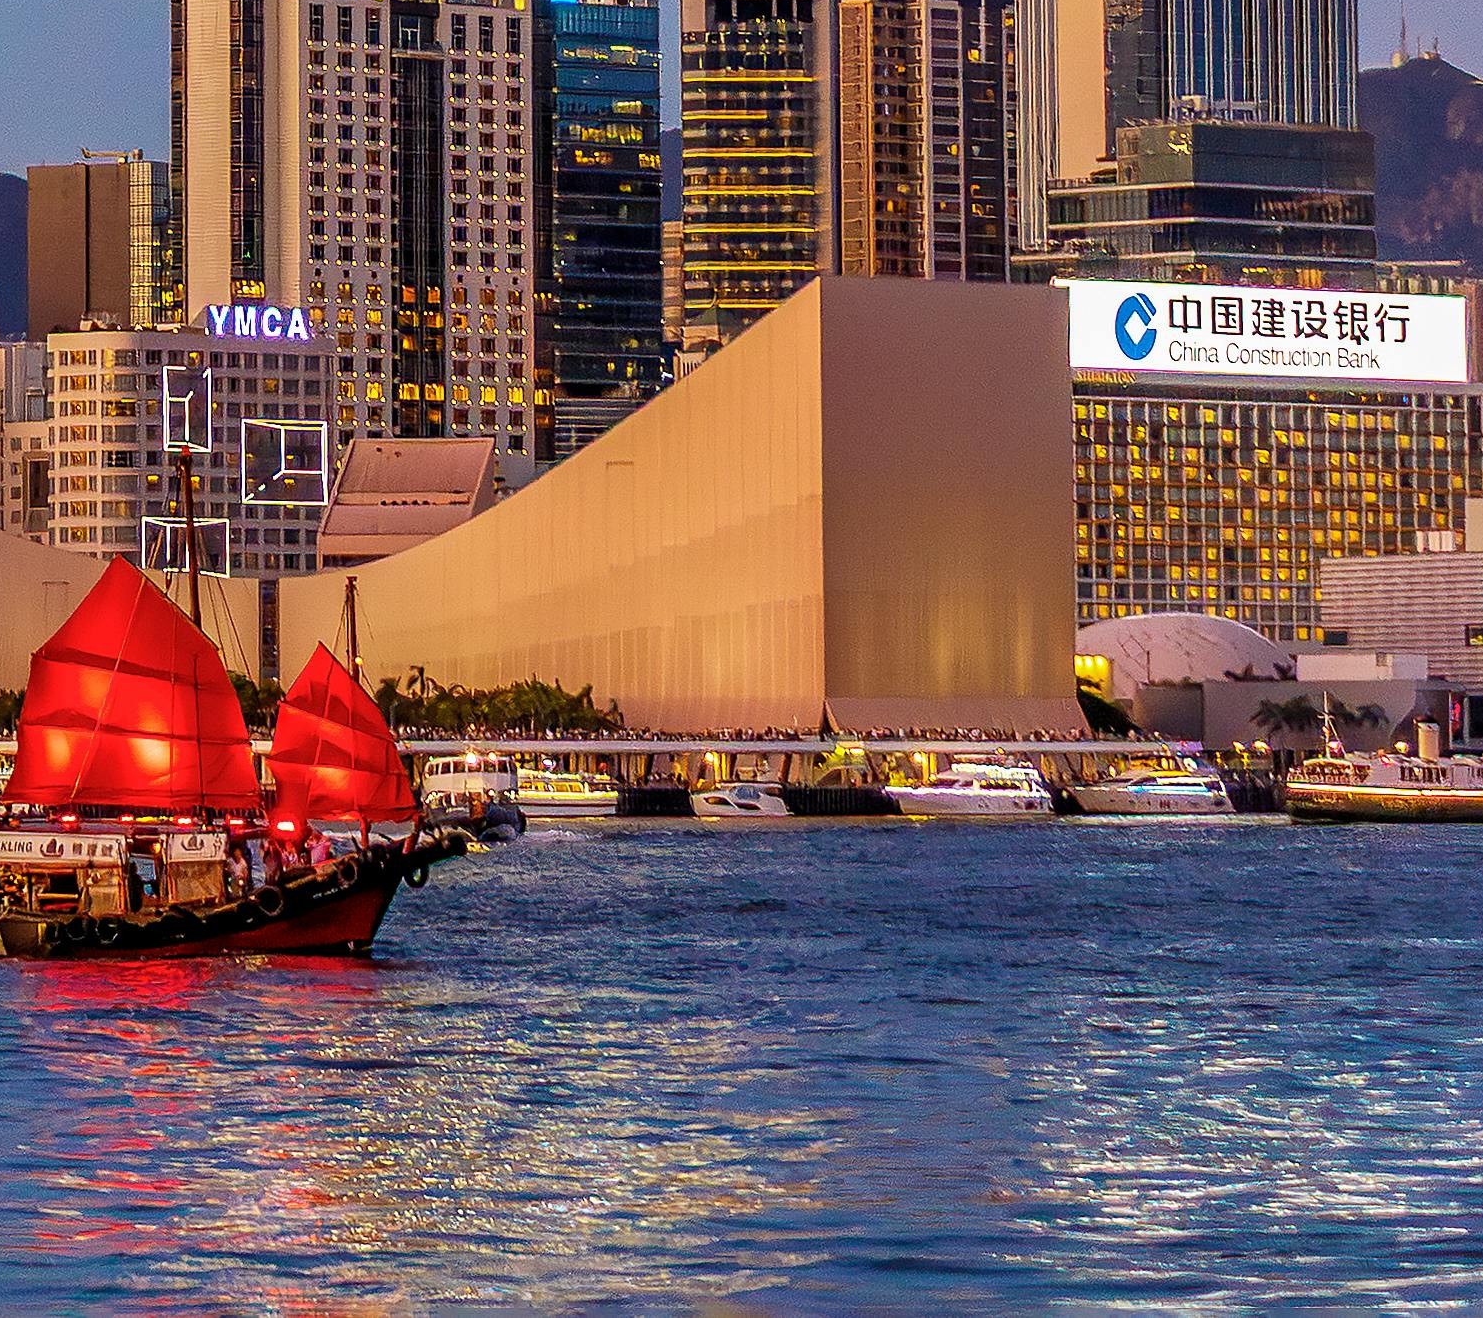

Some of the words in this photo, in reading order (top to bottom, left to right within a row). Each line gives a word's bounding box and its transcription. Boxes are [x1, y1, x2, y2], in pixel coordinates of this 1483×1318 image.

[208, 305, 309, 340] YMCA
[1169, 295, 1410, 345] 中国建设银行
[1168, 340, 1219, 363] China
[1226, 342, 1331, 367] Construction
[1338, 348, 1380, 369] Bank
